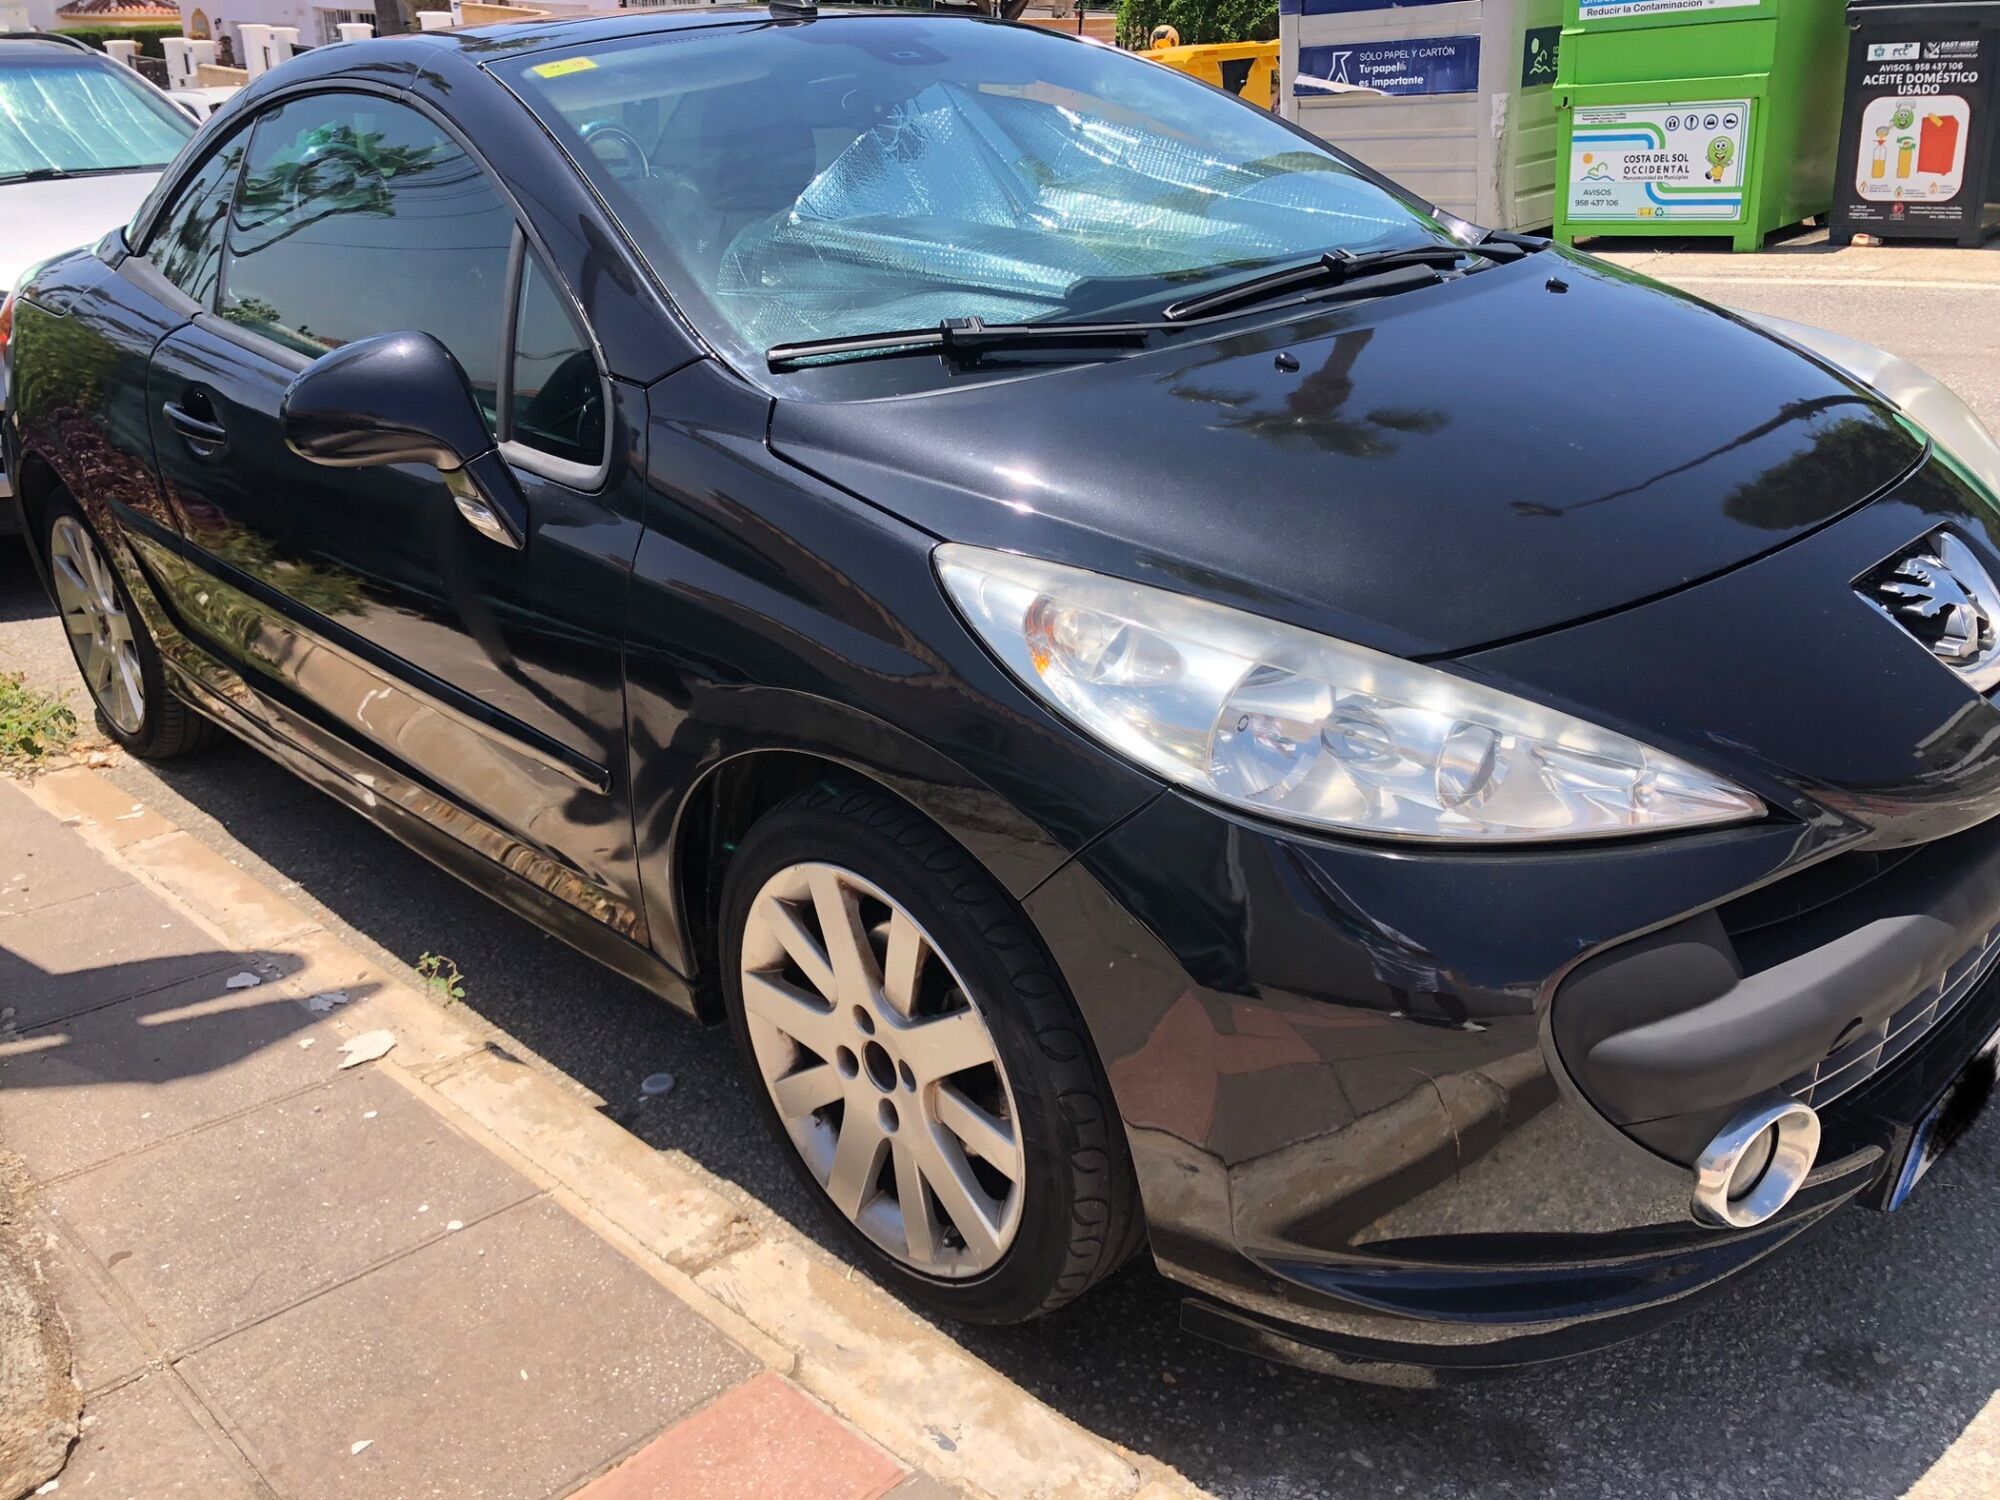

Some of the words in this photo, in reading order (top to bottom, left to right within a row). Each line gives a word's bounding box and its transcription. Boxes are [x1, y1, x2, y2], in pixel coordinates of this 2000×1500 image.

[1586, 6, 1621, 17] Reducir
[1623, 5, 1632, 13] la
[1384, 50, 1410, 60] PAPEL
[1411, 49, 1418, 58] Y
[1419, 46, 1455, 58] CARTÓN
[1880, 64, 1913, 72] AVISOS:
[1914, 63, 1930, 71] 958
[1931, 62, 1947, 70] 437
[1948, 62, 1963, 70] 106
[1359, 80, 1370, 88] es
[1371, 75, 1424, 88] importante
[1862, 74, 1904, 86] ACEITE
[1905, 70, 1979, 84] DOMÉSTICO
[1897, 84, 1941, 95] USADO
[1623, 154, 1652, 164] COSTA
[1653, 153, 1670, 163] DEL
[1671, 153, 1689, 163] SOL
[1623, 165, 1690, 174] OCCIDENTAL
[1583, 188, 1612, 196] AVISOS
[1575, 199, 1589, 207] 958
[1590, 199, 1604, 207] 437
[1605, 199, 1619, 207] 106
